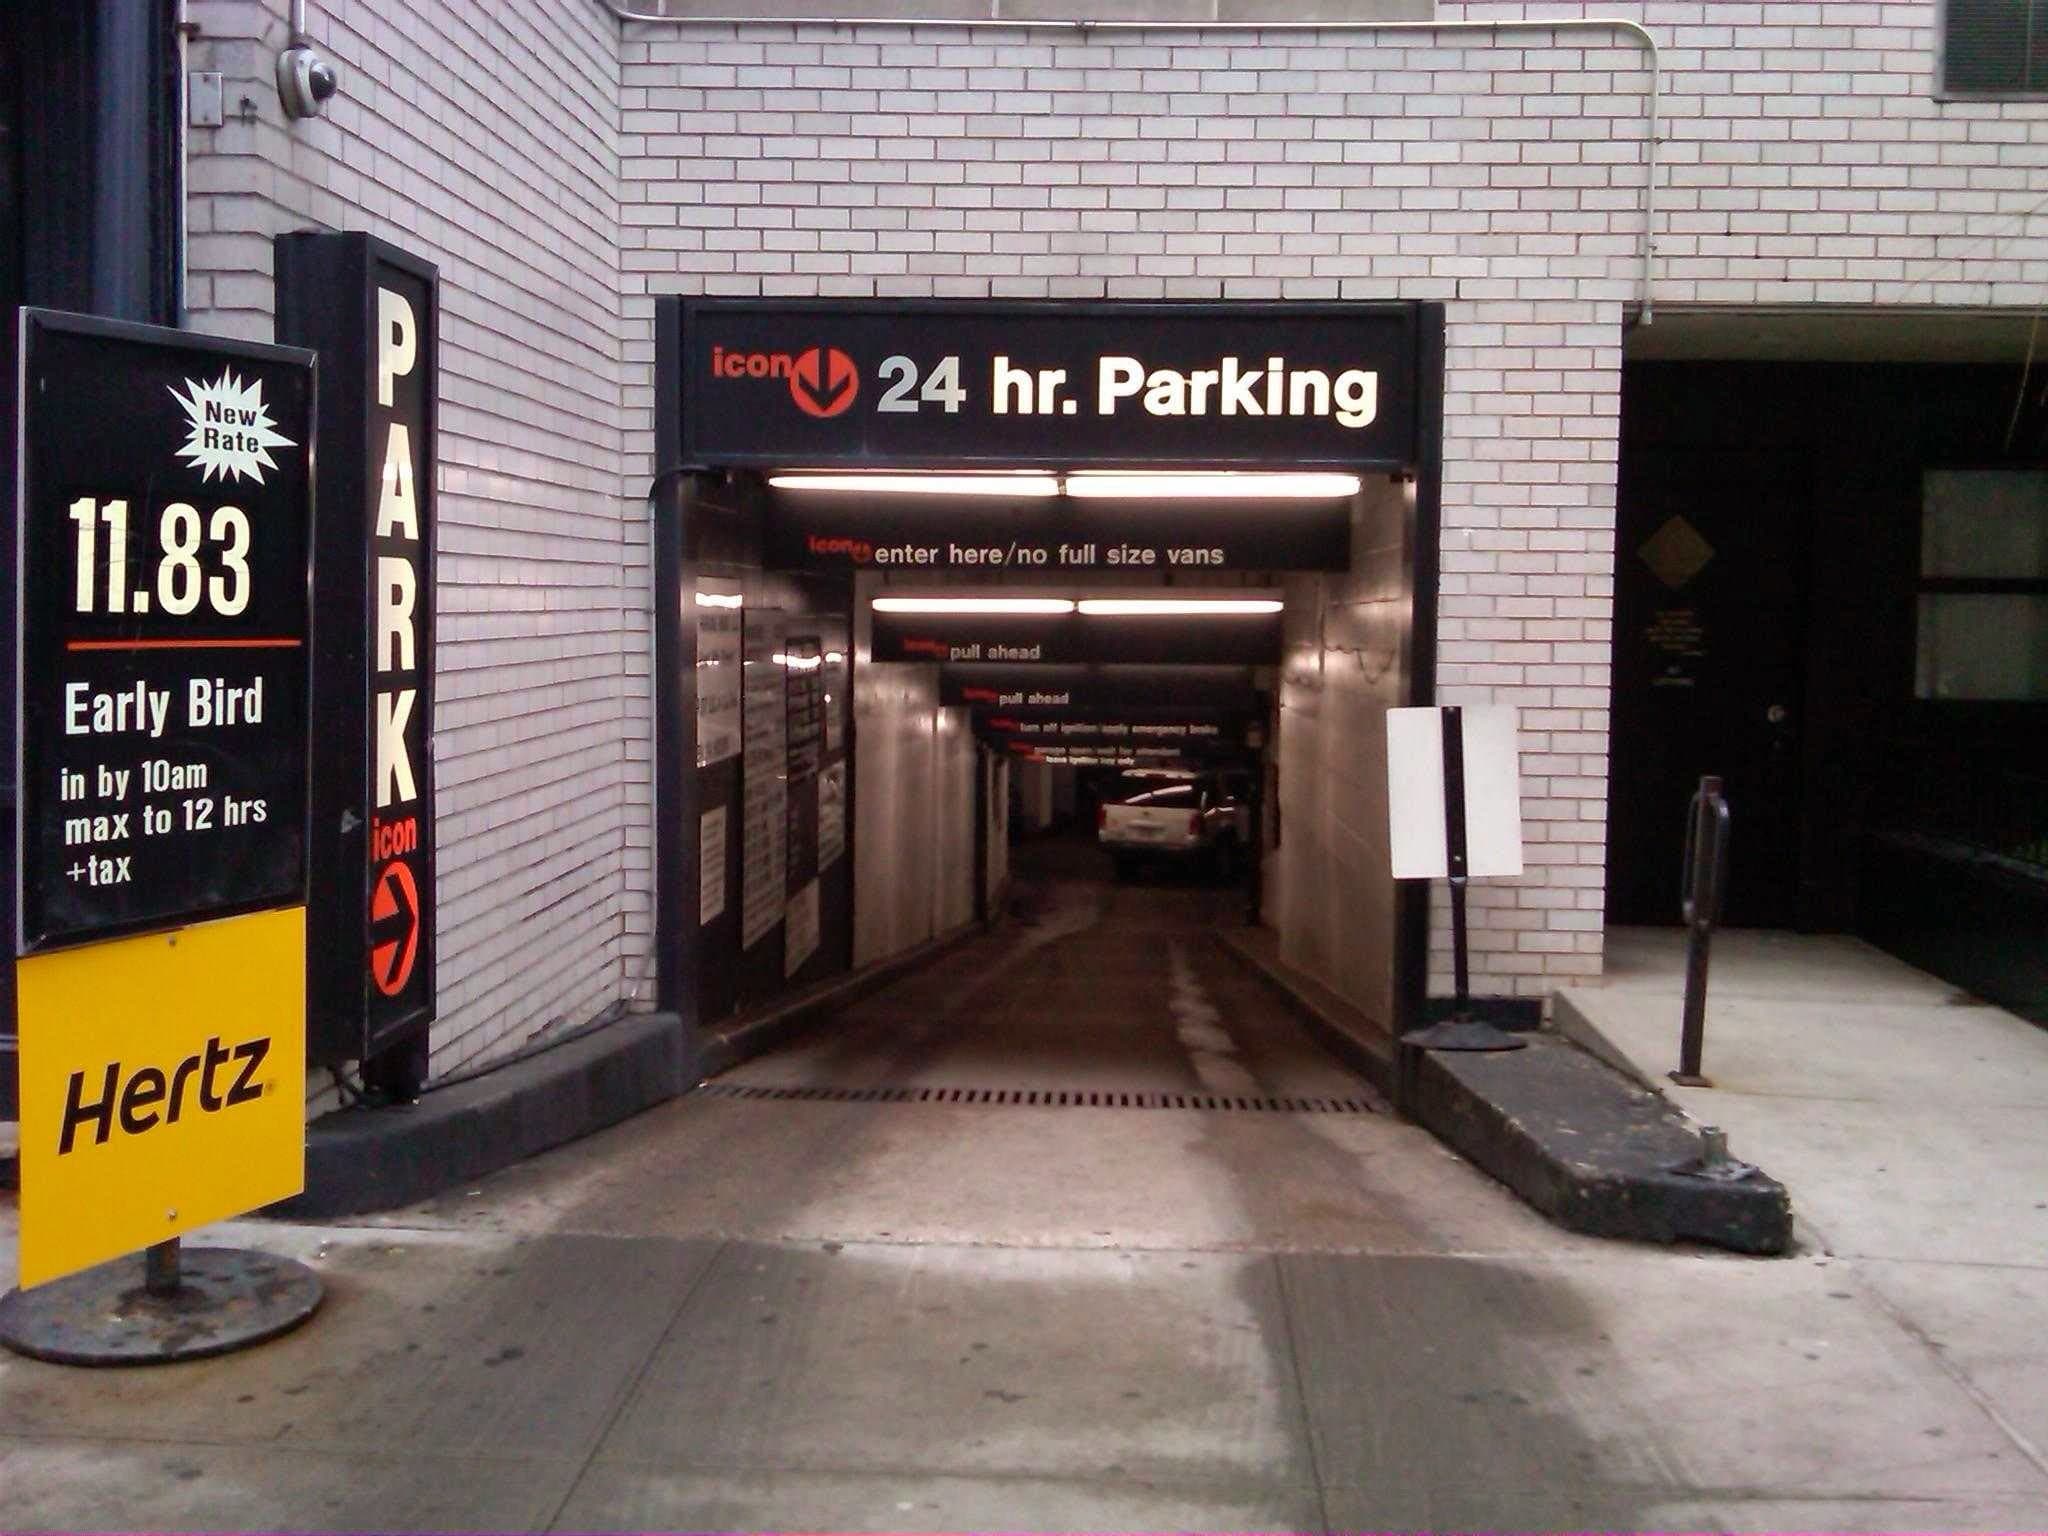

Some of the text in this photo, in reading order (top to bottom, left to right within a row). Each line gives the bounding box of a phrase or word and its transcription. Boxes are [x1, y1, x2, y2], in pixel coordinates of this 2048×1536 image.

[712, 346, 1380, 428] icon 24 hr. Parking
[205, 400, 257, 427] New
[204, 427, 259, 453] Rate
[69, 497, 251, 616] 11.83
[375, 286, 420, 808] PARK
[875, 544, 939, 564] enter
[1059, 543, 1096, 565] full
[1106, 543, 1157, 565] size
[1167, 547, 1225, 565] vans
[950, 643, 981, 661] pull
[987, 644, 1041, 660] ahead
[65, 676, 263, 738] Early Bird
[61, 759, 208, 801] in by 10am
[65, 795, 268, 846] max to 12 hrs
[371, 816, 417, 863] icon
[66, 854, 131, 886] +tax
[58, 1036, 271, 1155] Hertz
